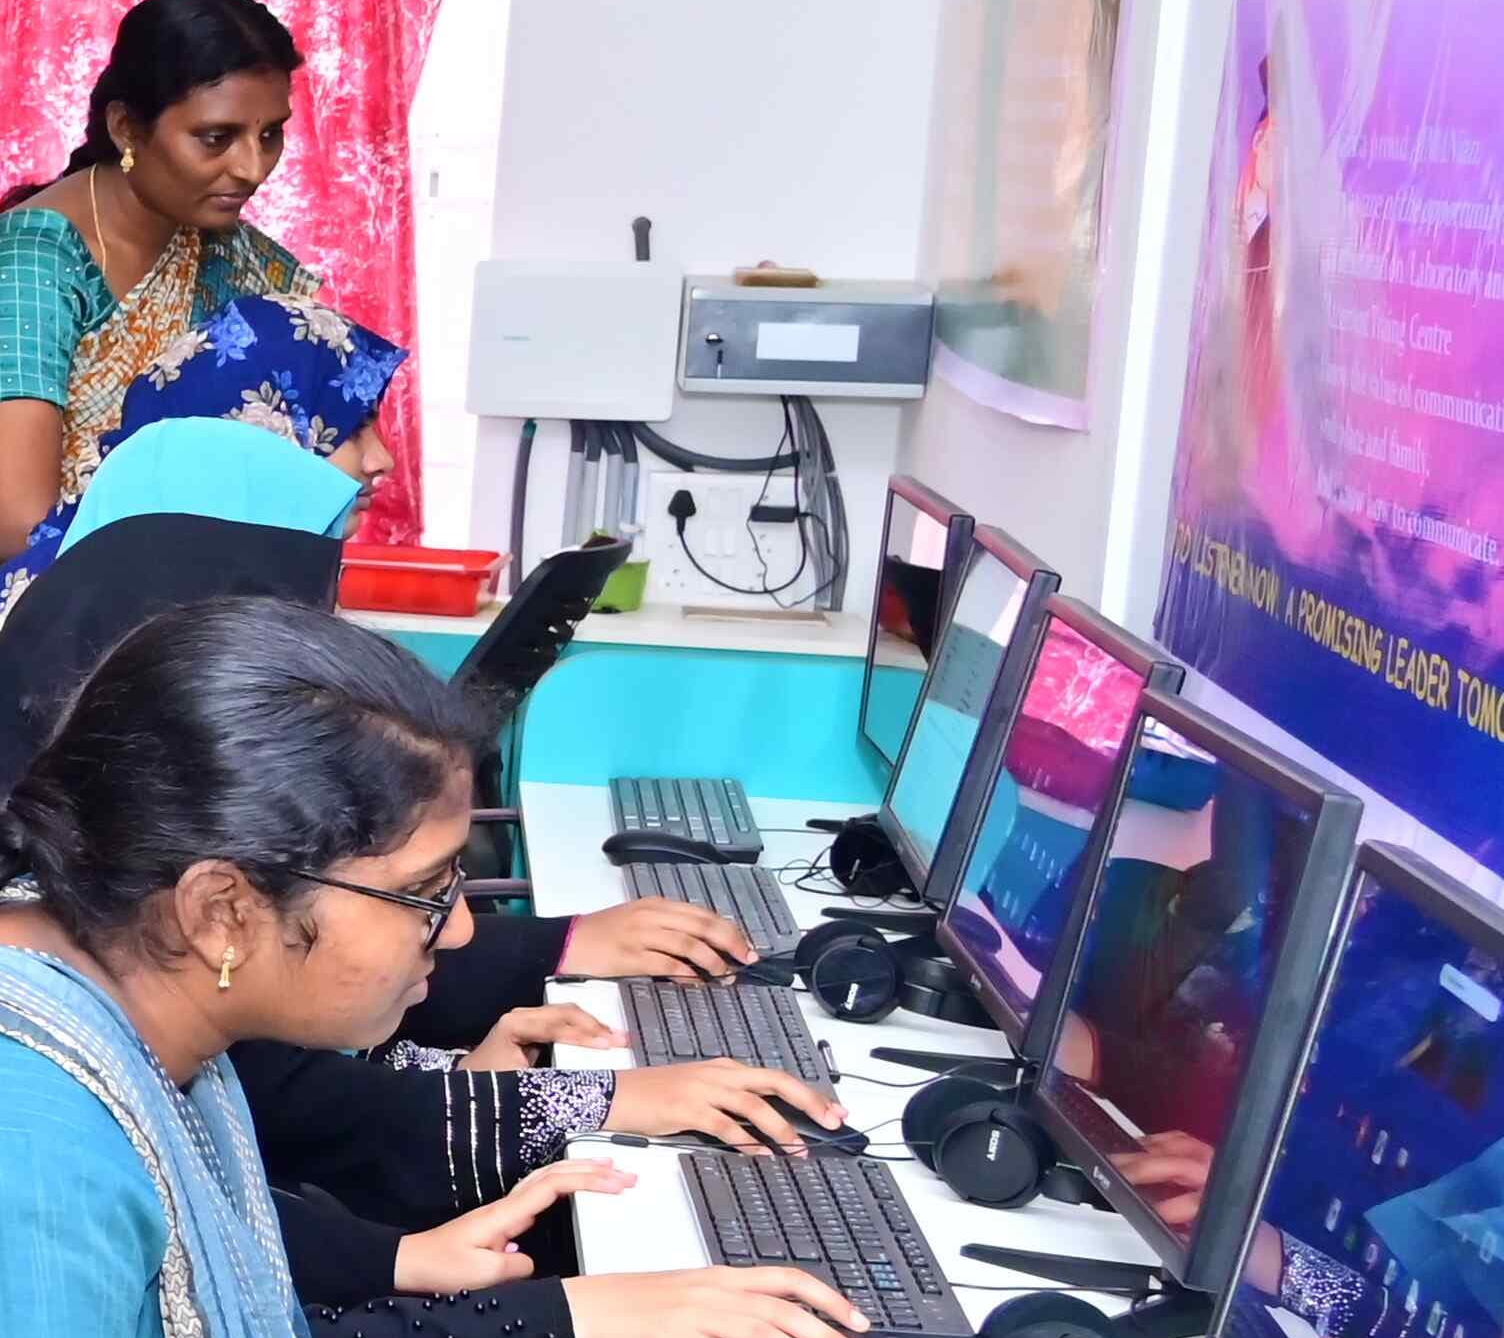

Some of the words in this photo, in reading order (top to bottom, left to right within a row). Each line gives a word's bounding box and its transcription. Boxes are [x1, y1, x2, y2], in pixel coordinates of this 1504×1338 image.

[1409, 311, 1453, 356] Centre
[1285, 586, 1295, 628] A
[1297, 589, 1383, 675] PROMISING
[1385, 635, 1450, 711] LEADER
[987, 1130, 1000, 1161] SONY
